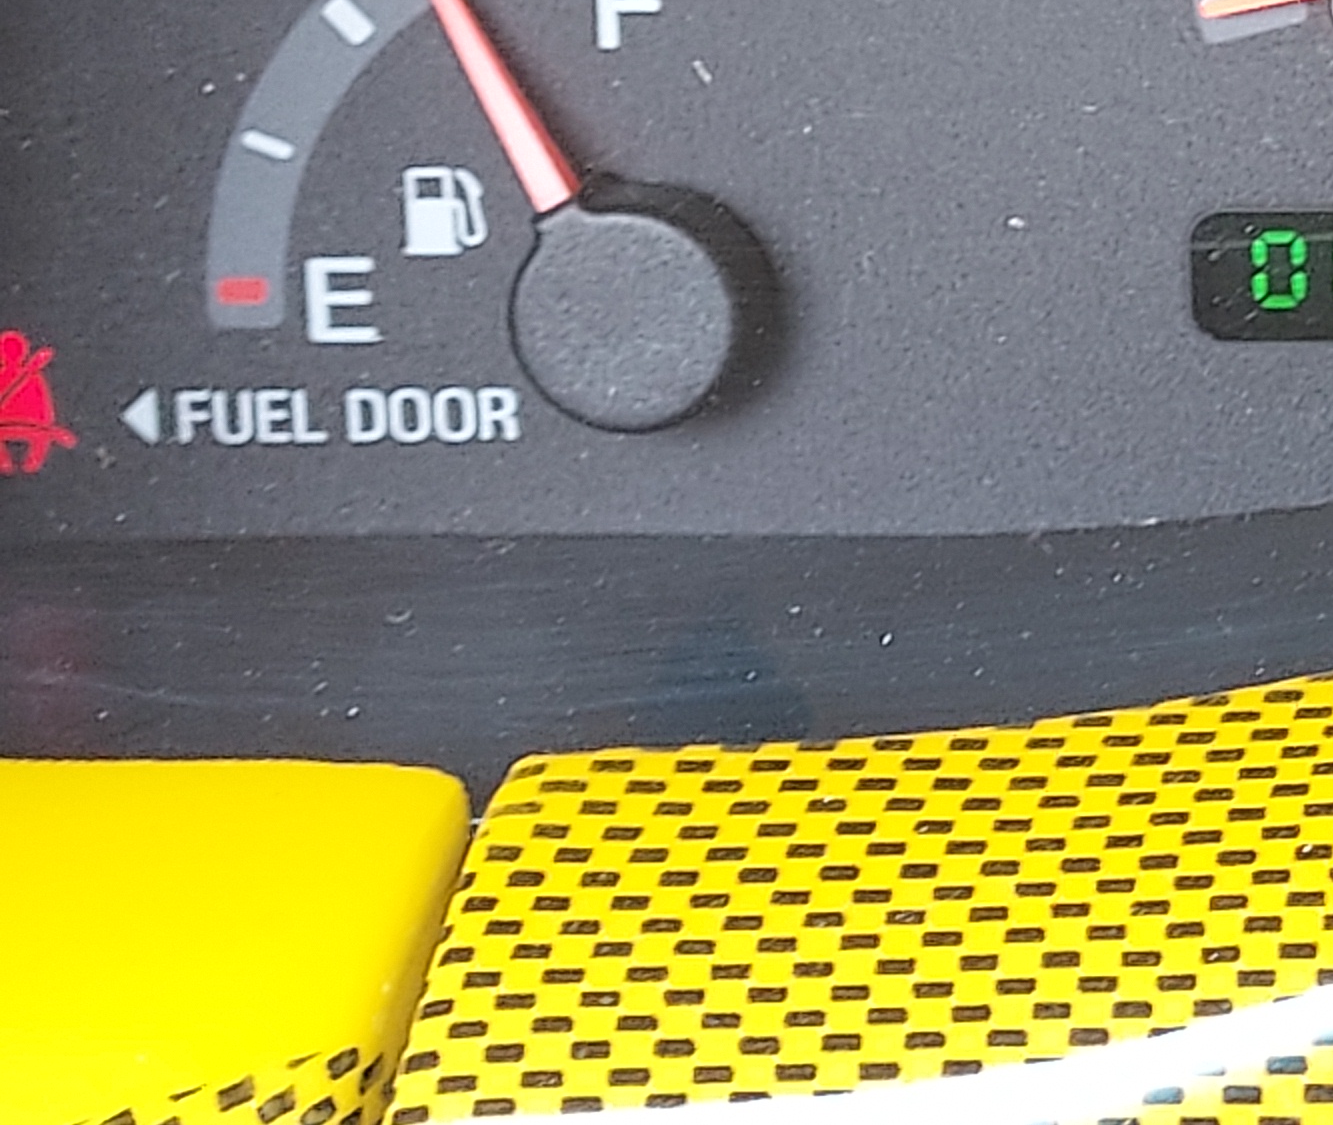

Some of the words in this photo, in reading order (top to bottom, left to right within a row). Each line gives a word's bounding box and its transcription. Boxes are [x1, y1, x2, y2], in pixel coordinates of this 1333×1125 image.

[304, 256, 383, 343] E
[176, 390, 327, 444] FUEL
[345, 387, 520, 443] DOOR
